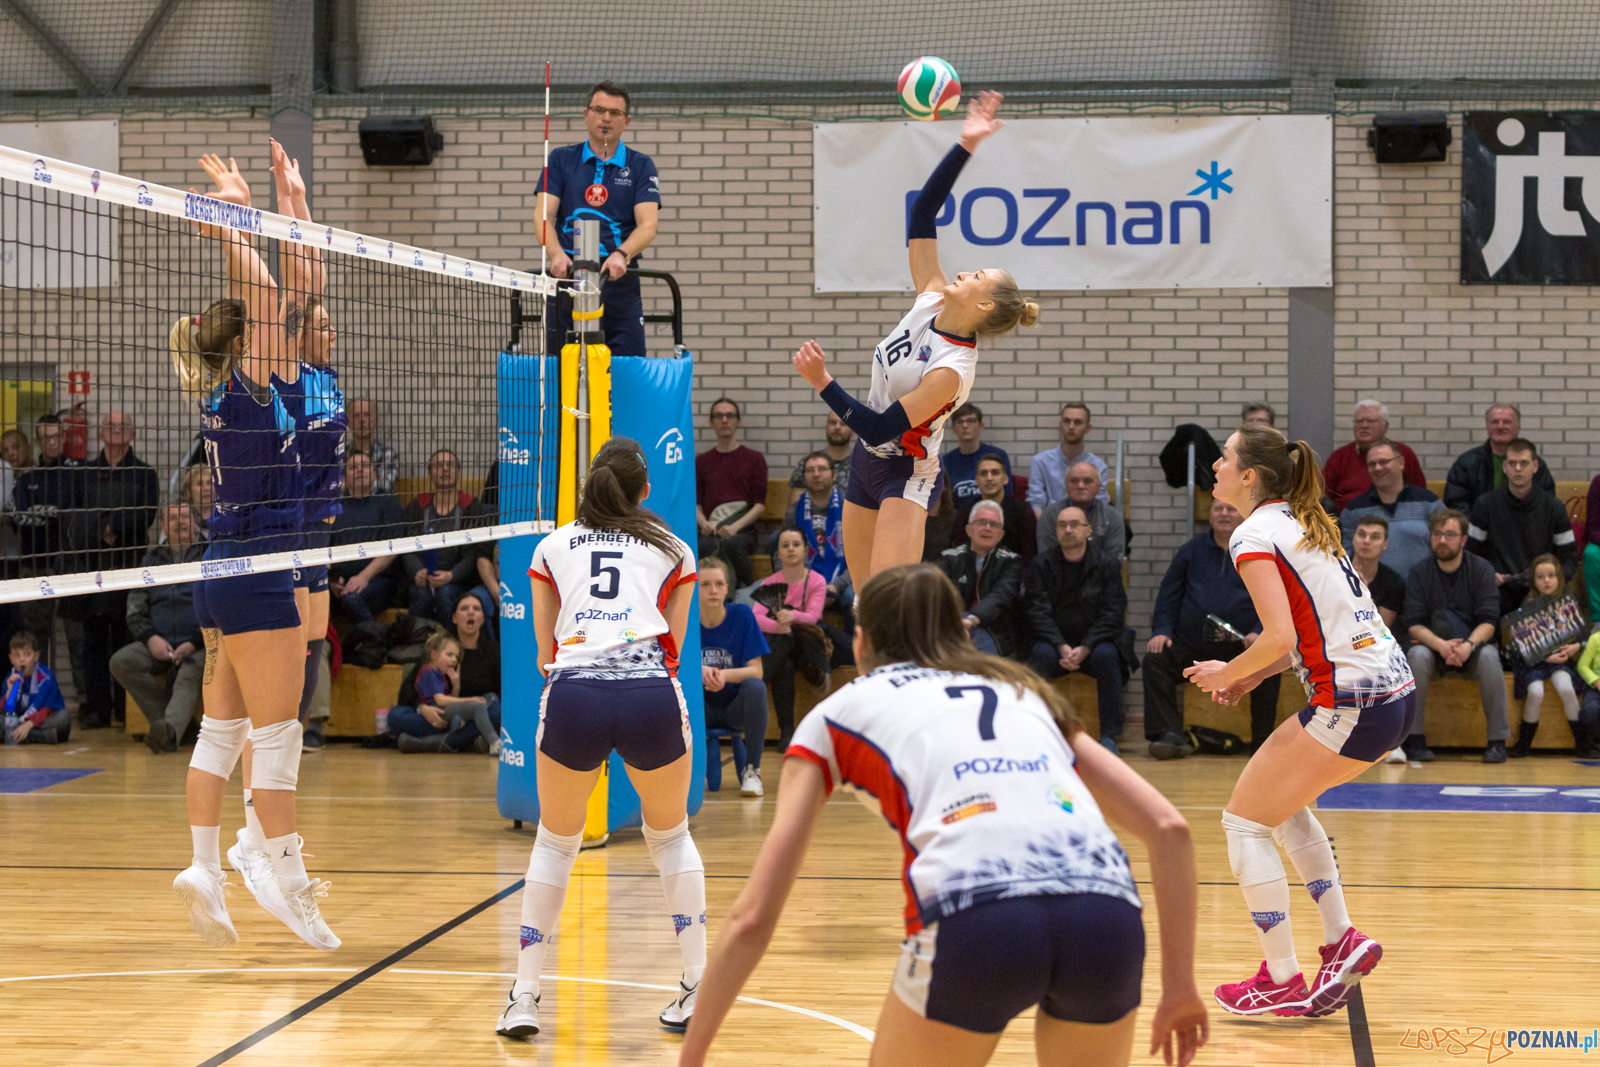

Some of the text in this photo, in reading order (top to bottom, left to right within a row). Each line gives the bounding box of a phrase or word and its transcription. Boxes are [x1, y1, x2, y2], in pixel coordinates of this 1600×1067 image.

[886, 329, 912, 367] 16
[589, 551, 624, 600] 5
[943, 685, 998, 741] 7
